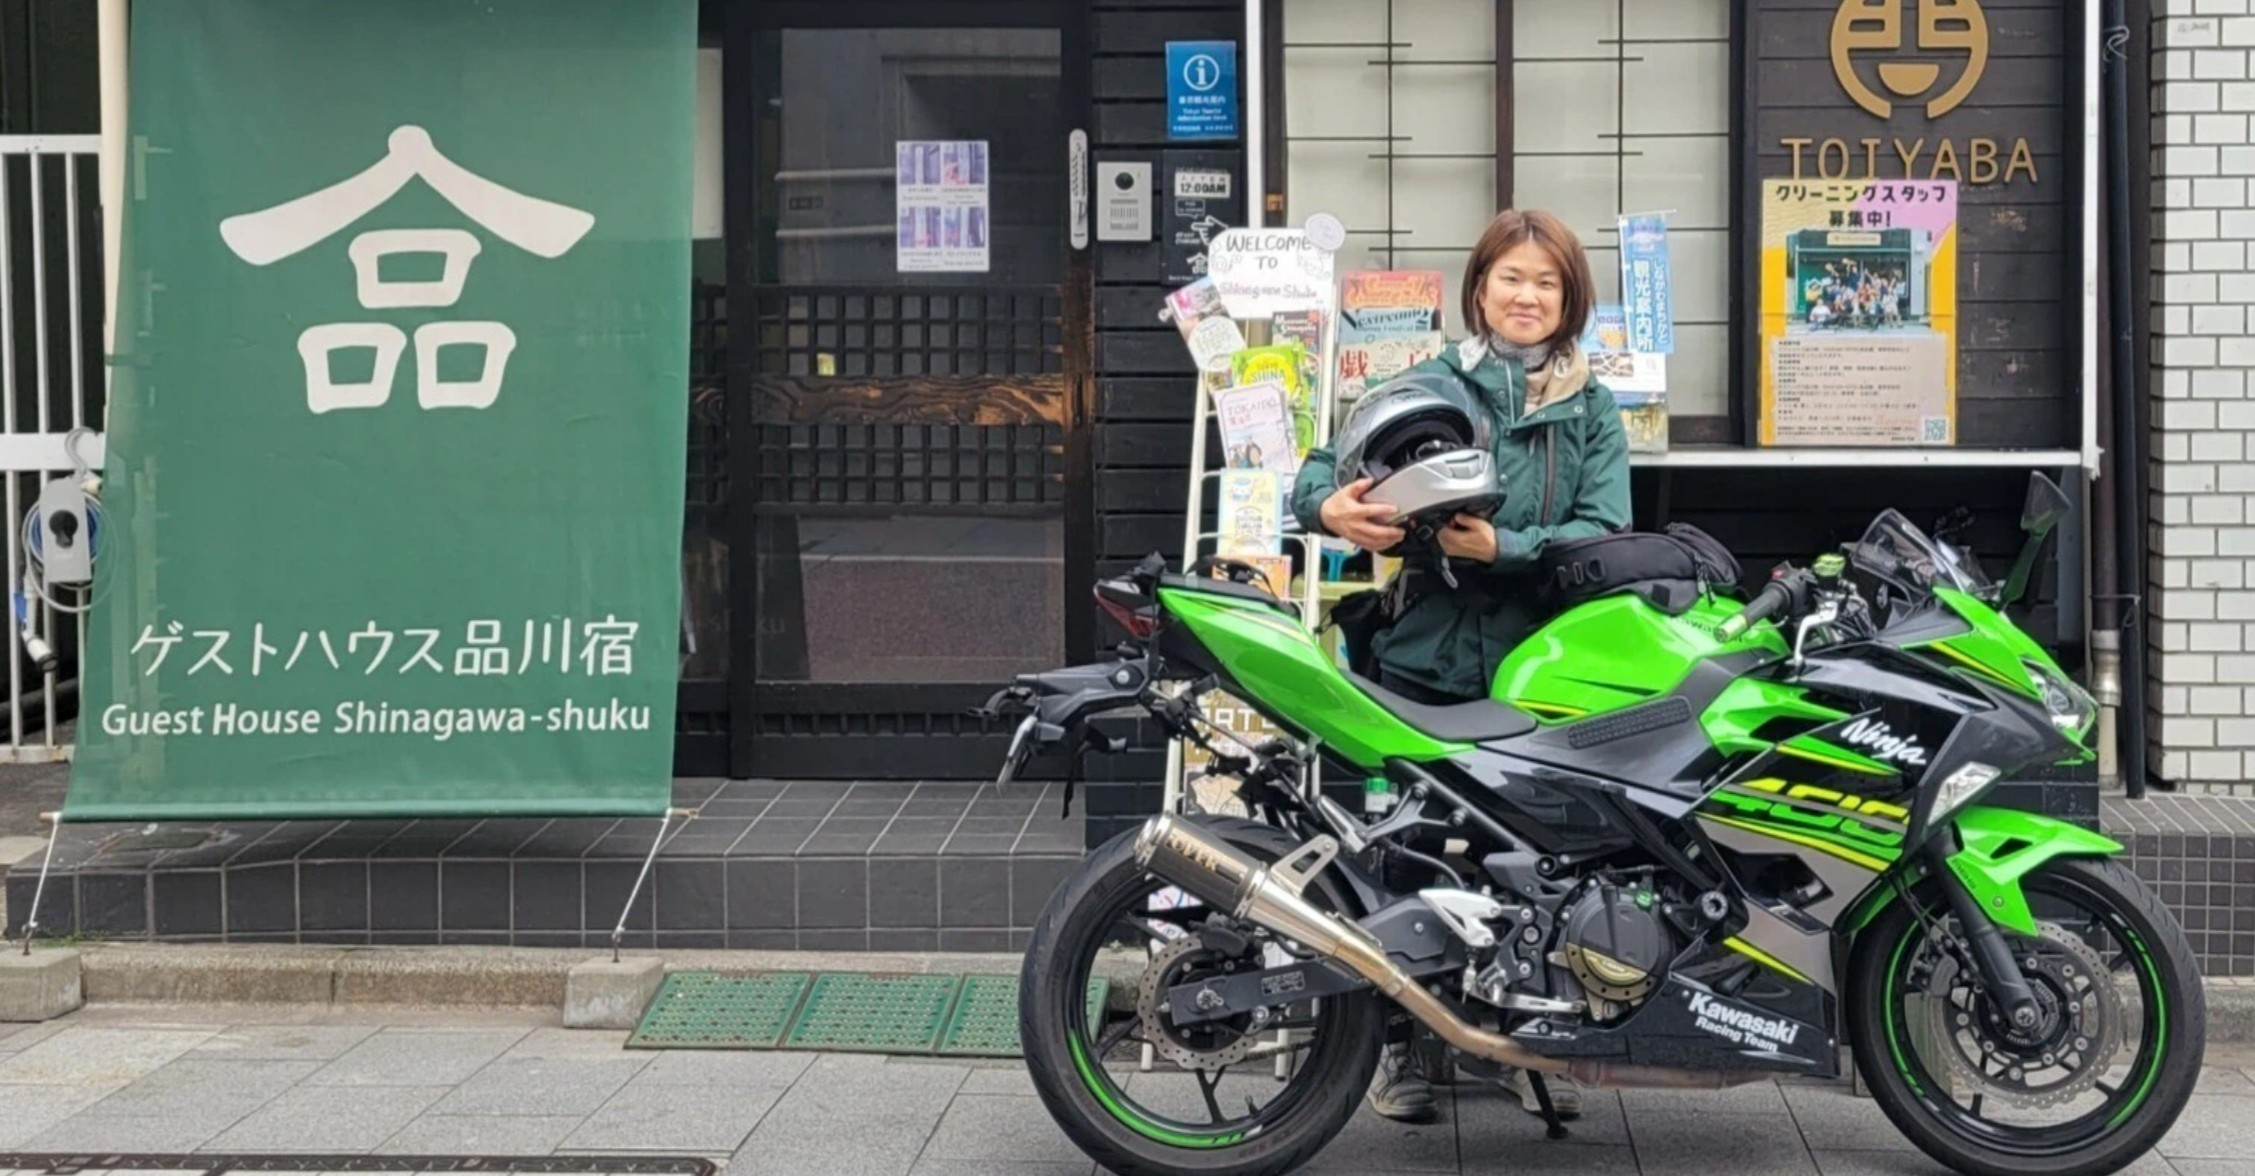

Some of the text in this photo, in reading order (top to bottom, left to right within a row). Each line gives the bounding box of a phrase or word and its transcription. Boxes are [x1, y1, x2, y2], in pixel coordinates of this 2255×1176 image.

[1780, 137, 2039, 184] TOIYABA
[1180, 182, 1227, 194] 12:00AM
[1776, 185, 1947, 202] クリーニングスタッフ
[1829, 210, 1892, 229] 募集中!
[1226, 233, 1313, 252] WELCOME
[1256, 255, 1279, 270] TO
[130, 613, 640, 677] ゲストハウス品川宿
[102, 697, 651, 742] Guest House Shinagawa-shuku
[1839, 717, 1927, 765] Ninja
[1688, 990, 1800, 1045] Kawasaki
[1695, 1015, 1779, 1053] Racing Team
